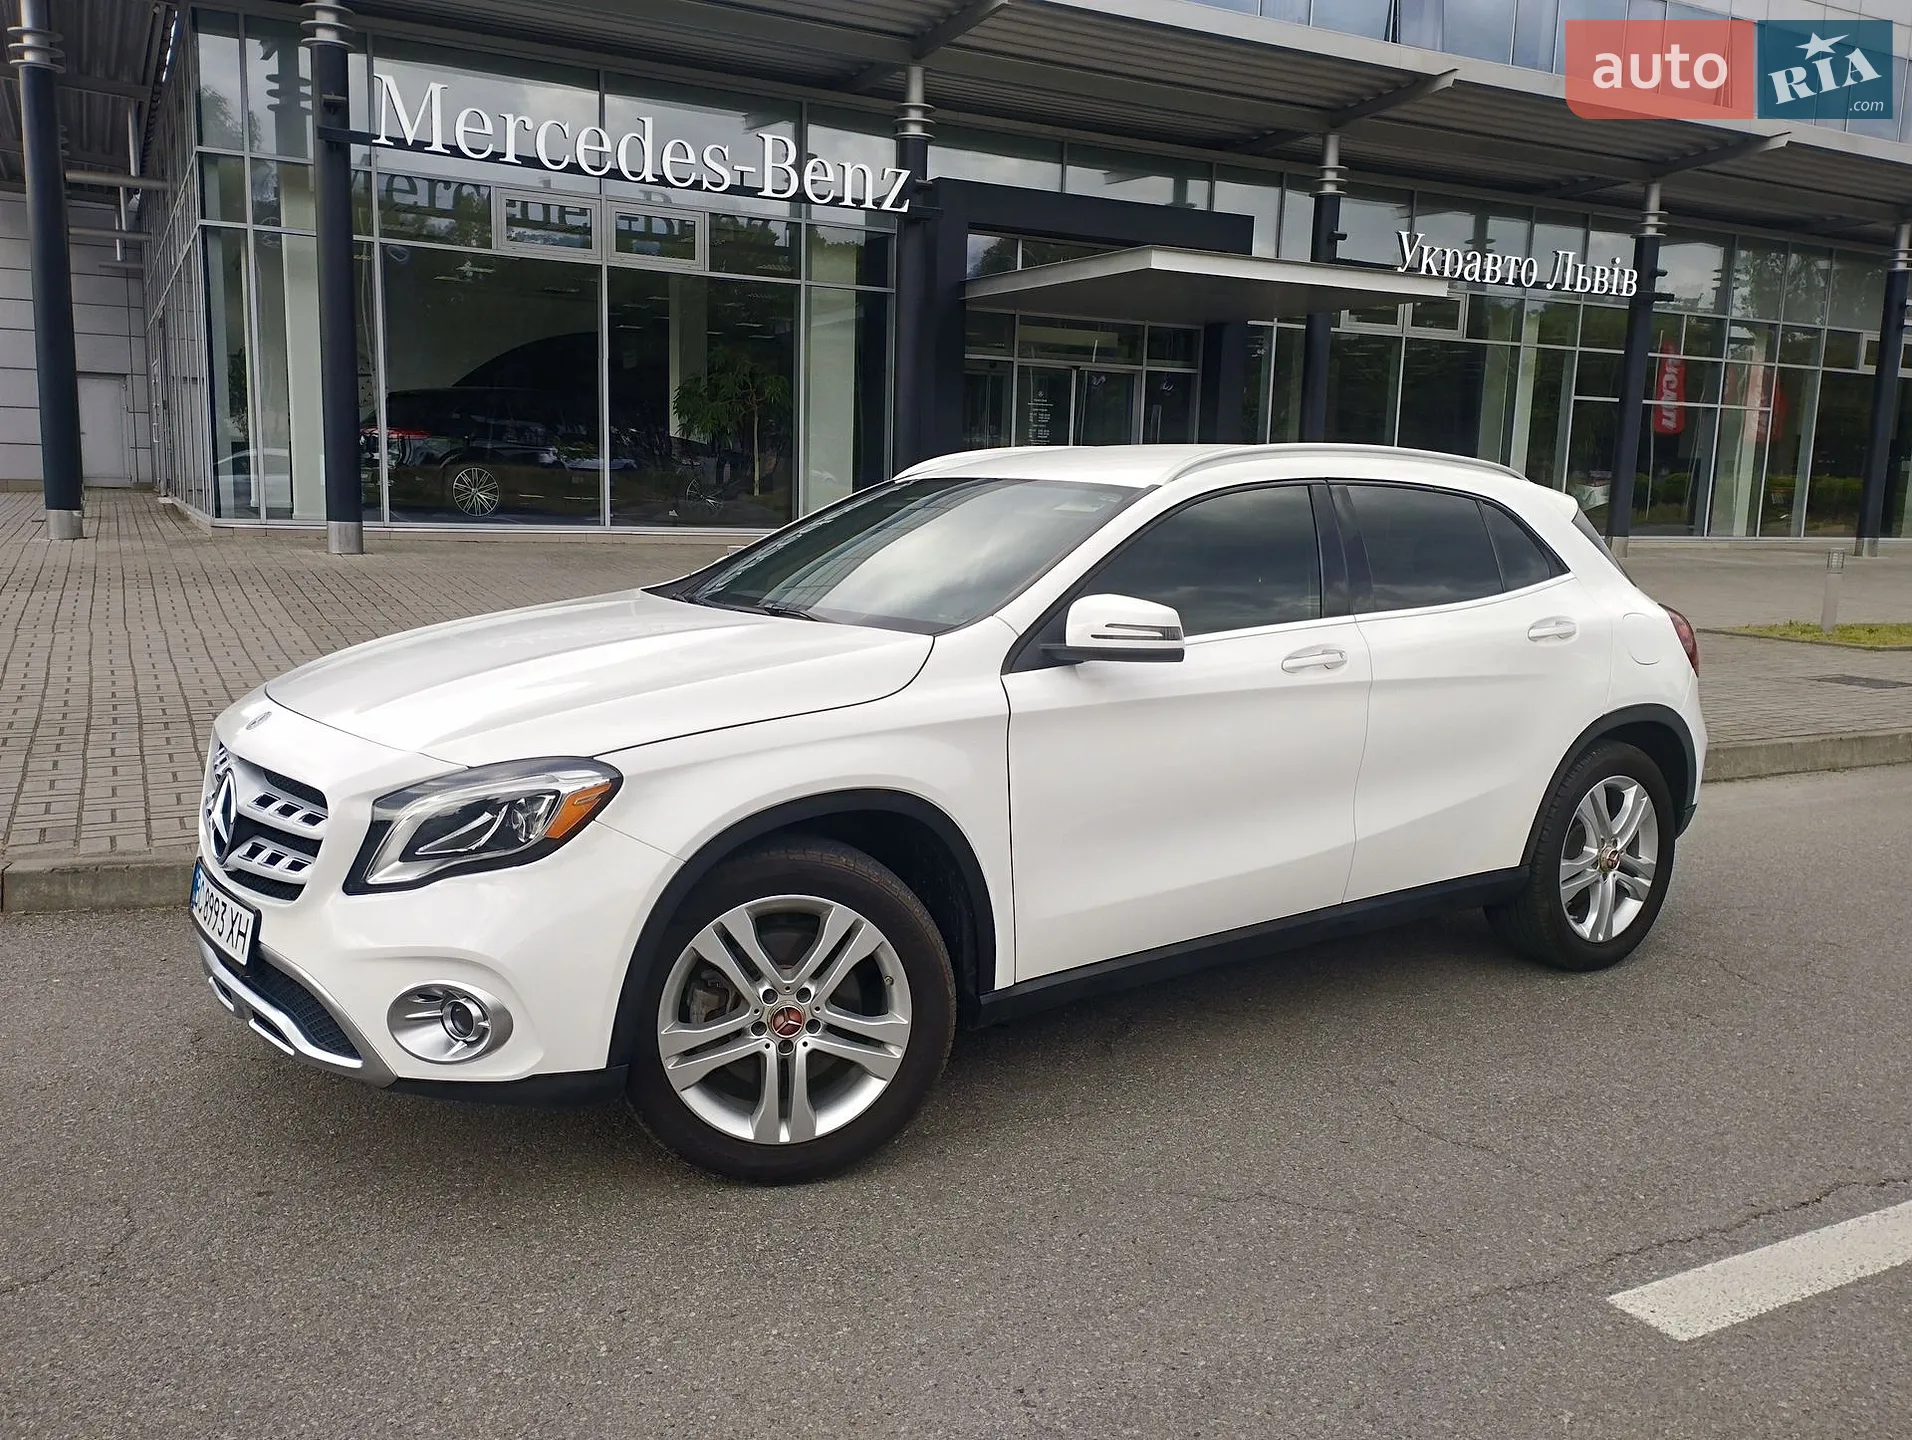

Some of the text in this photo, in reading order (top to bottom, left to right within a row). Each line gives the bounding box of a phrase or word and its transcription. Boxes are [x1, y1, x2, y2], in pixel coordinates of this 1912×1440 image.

[373, 73, 911, 214] Mercedes-Benz
[1396, 231, 1638, 297] Укравто Львів
[203, 888, 227, 937] 8993
[226, 907, 250, 955] XH
